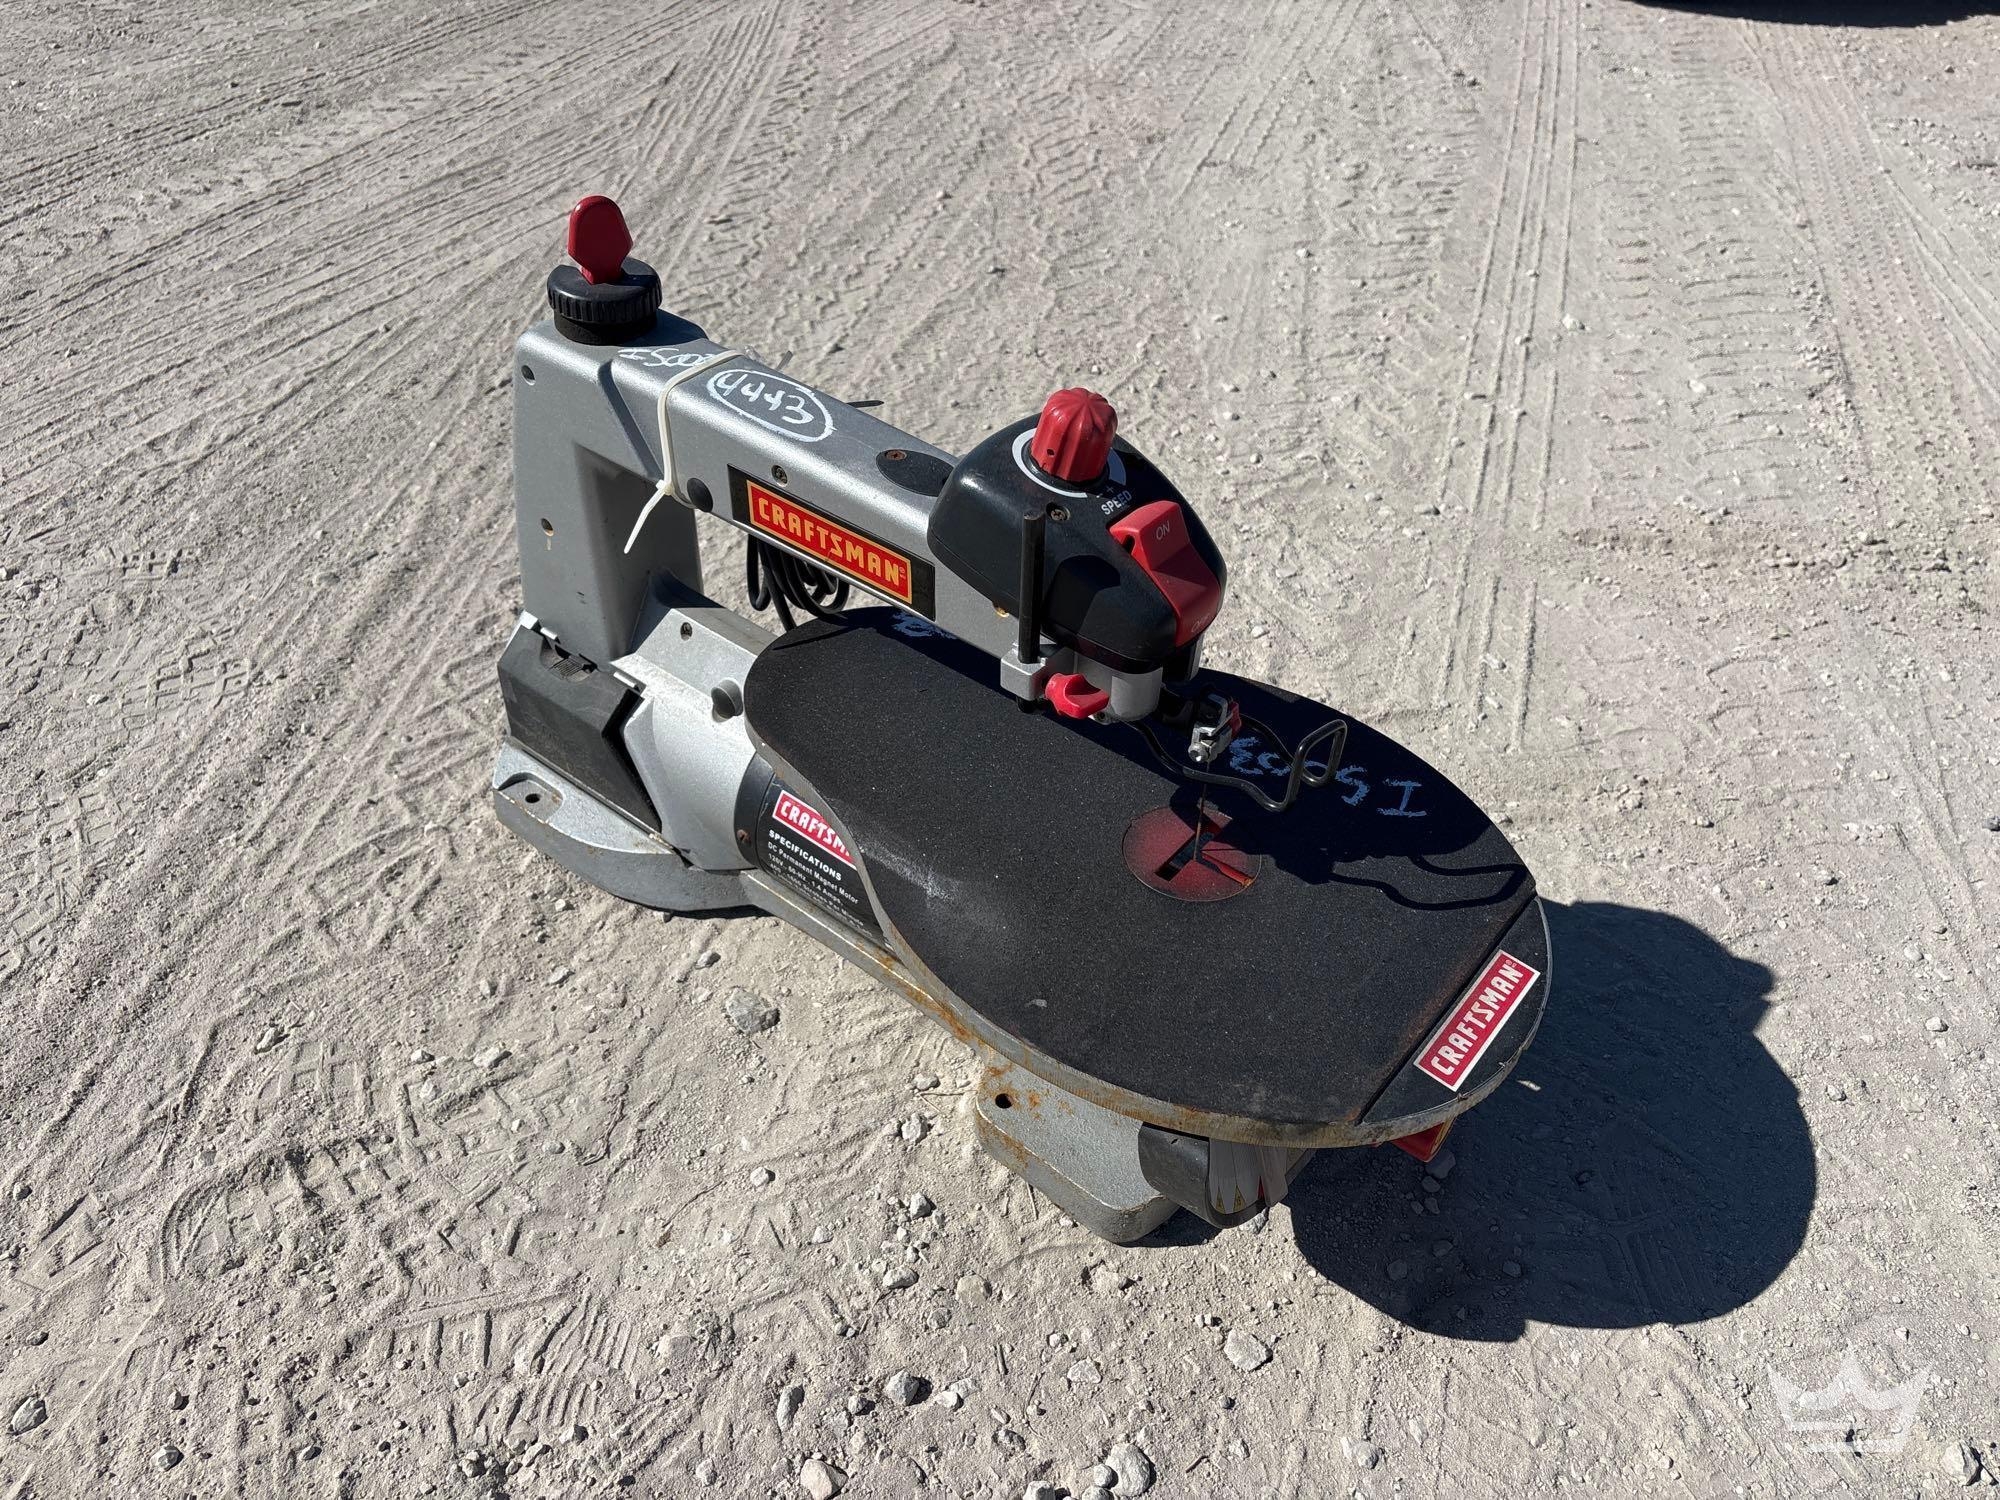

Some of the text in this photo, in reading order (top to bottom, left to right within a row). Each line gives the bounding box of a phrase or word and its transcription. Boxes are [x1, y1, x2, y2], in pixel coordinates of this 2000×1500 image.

[714, 373, 814, 424] 4443
[1101, 490, 1132, 515] SPEED
[758, 497, 900, 586] CRAFTSMAN
[1155, 521, 1170, 541] ON
[768, 829, 842, 881] SPECIFICATIONS
[781, 800, 851, 856] CRAFTSM
[768, 841, 778, 853] DC
[778, 847, 813, 875] Permanent
[814, 871, 838, 892] Magnet
[839, 887, 859, 904] Motor
[1430, 963, 1524, 1076] CRAFTSMAN
